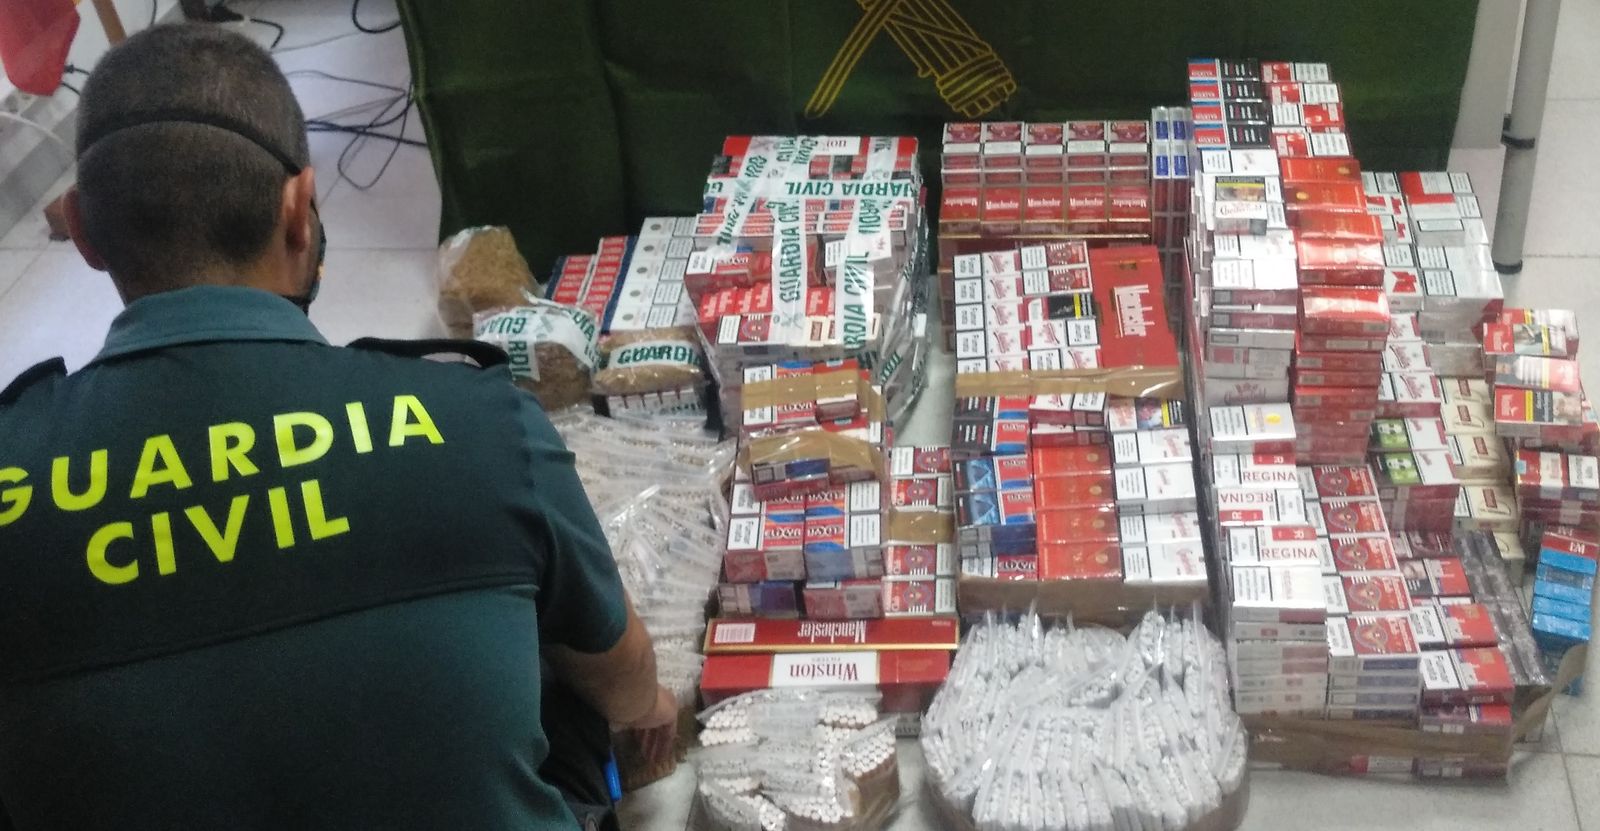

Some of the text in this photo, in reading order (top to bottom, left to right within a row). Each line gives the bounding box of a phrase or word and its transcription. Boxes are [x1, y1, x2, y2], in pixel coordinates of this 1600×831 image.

[786, 182, 834, 196] CIVIL
[779, 228, 802, 302] GUARDIA
[844, 304, 868, 349] RDIA
[0, 395, 445, 527] GUARDIA
[1243, 471, 1296, 482] REGINA
[1219, 493, 1274, 503] REGINA
[86, 479, 351, 585] CIVIL
[1261, 547, 1319, 559] REGINA
[798, 621, 866, 643] Manchester
[789, 663, 859, 681] Winston
